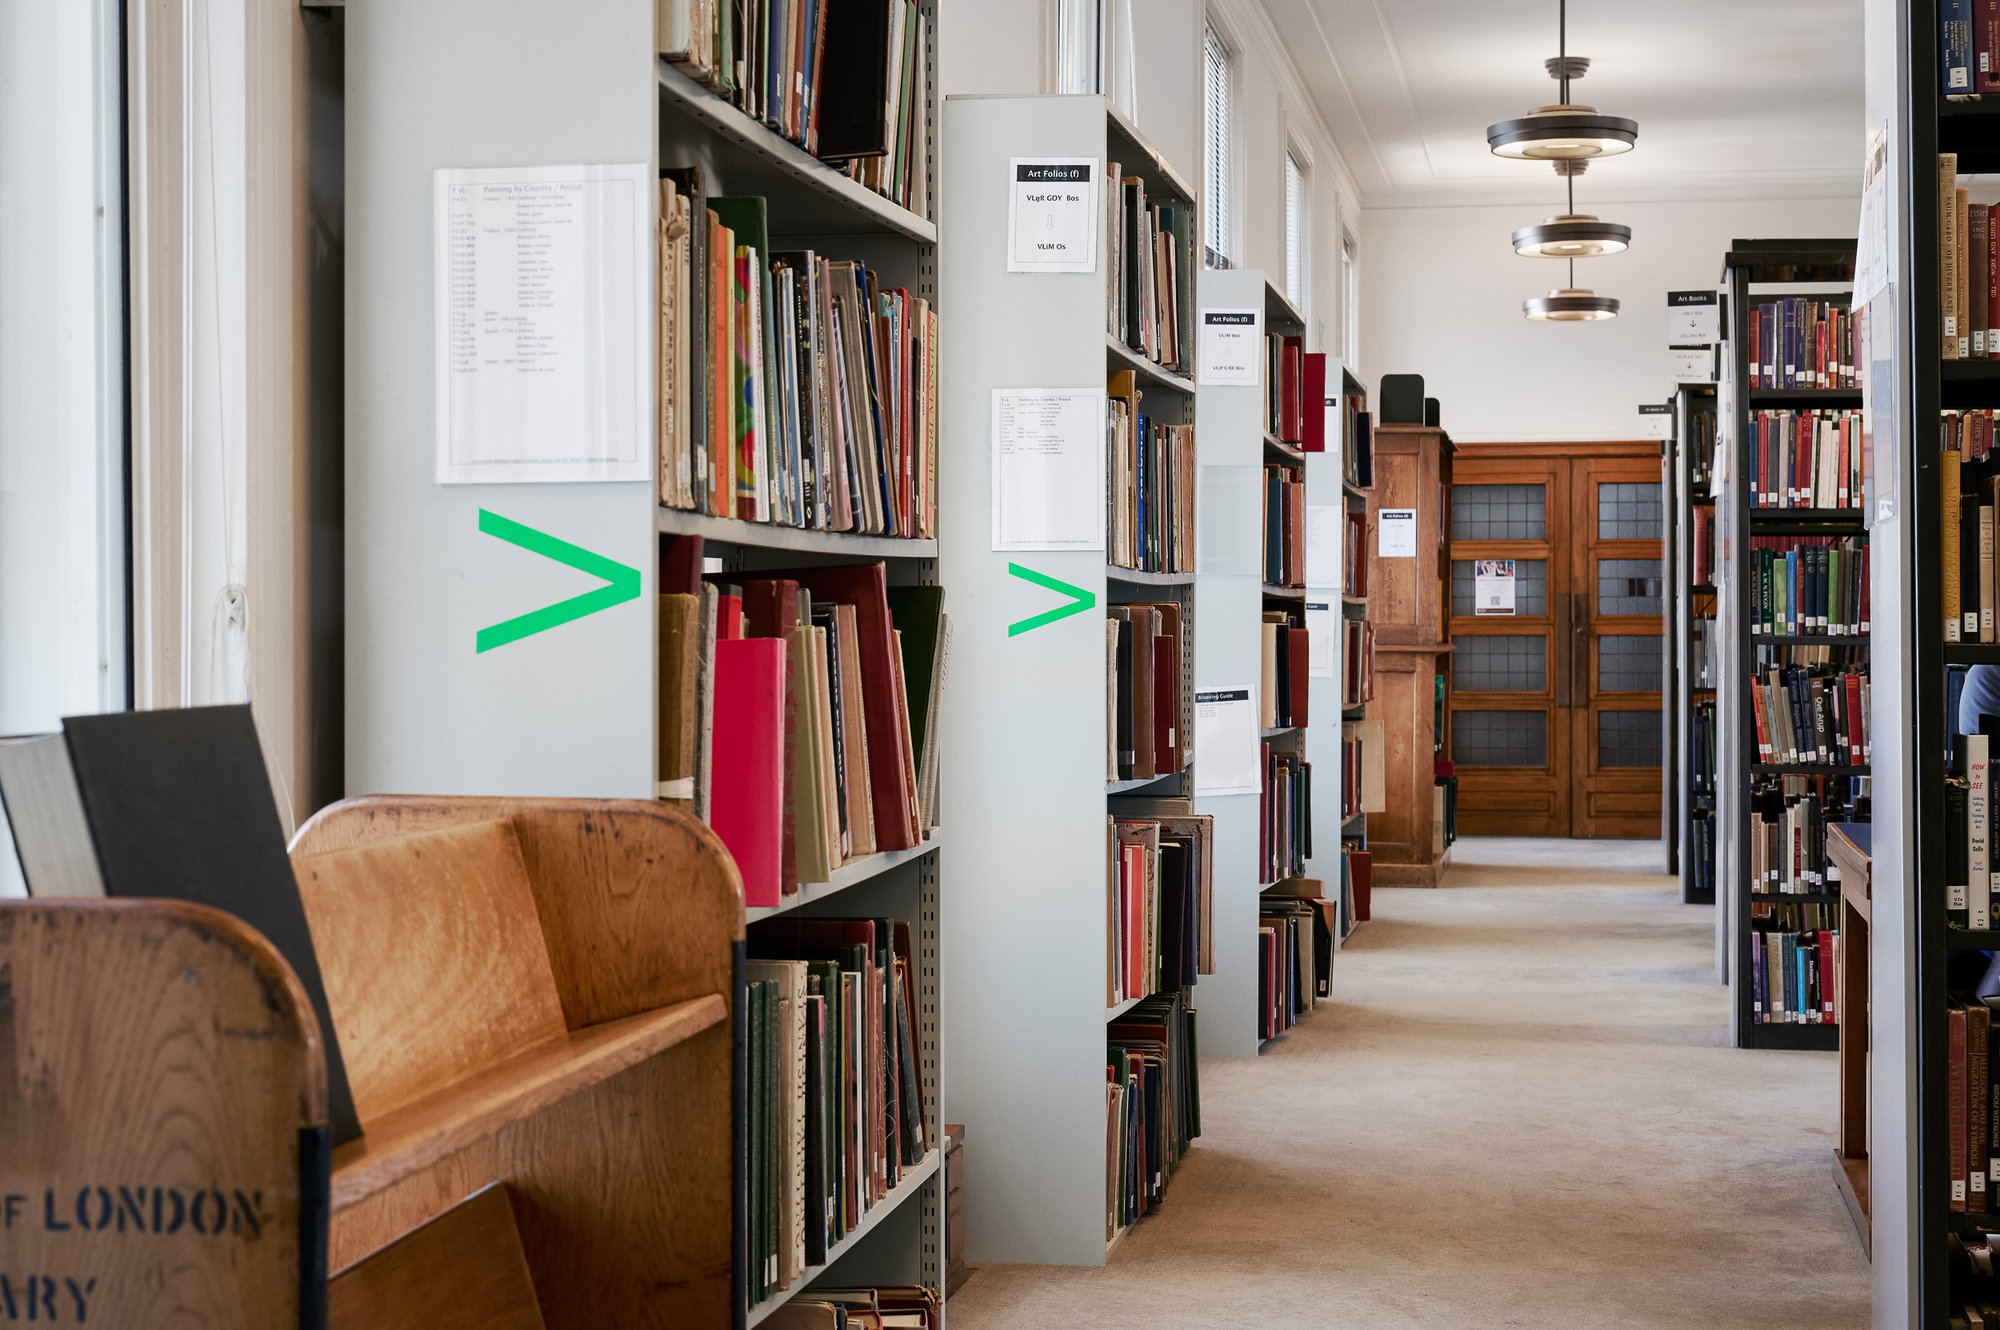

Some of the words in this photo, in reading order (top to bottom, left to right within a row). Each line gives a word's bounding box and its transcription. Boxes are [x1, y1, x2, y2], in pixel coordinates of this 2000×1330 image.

[1028, 170, 1041, 178] Art
[1043, 170, 1068, 178] Folios
[1070, 169, 1080, 179] (f)
[483, 186, 512, 195] Painting
[514, 185, 522, 193] by
[524, 184, 552, 193] Country
[1026, 195, 1045, 203] VLgR
[1946, 249, 1953, 260] OF
[1689, 294, 1707, 302] Books
[928, 317, 937, 414] MANGUIN
[1974, 417, 1982, 438] JOHN
[1817, 713, 1825, 733] Arup
[1970, 1055, 1979, 1108] MIGRATION
[1979, 1056, 1987, 1101] ALLEGORY
[1970, 1111, 1978, 1123] OF
[1979, 1104, 1987, 1124] AND
[1970, 1125, 1978, 1166] SYMBOLS
[1979, 1127, 1987, 1144] THE
[45, 1186, 262, 1239] LONDON
